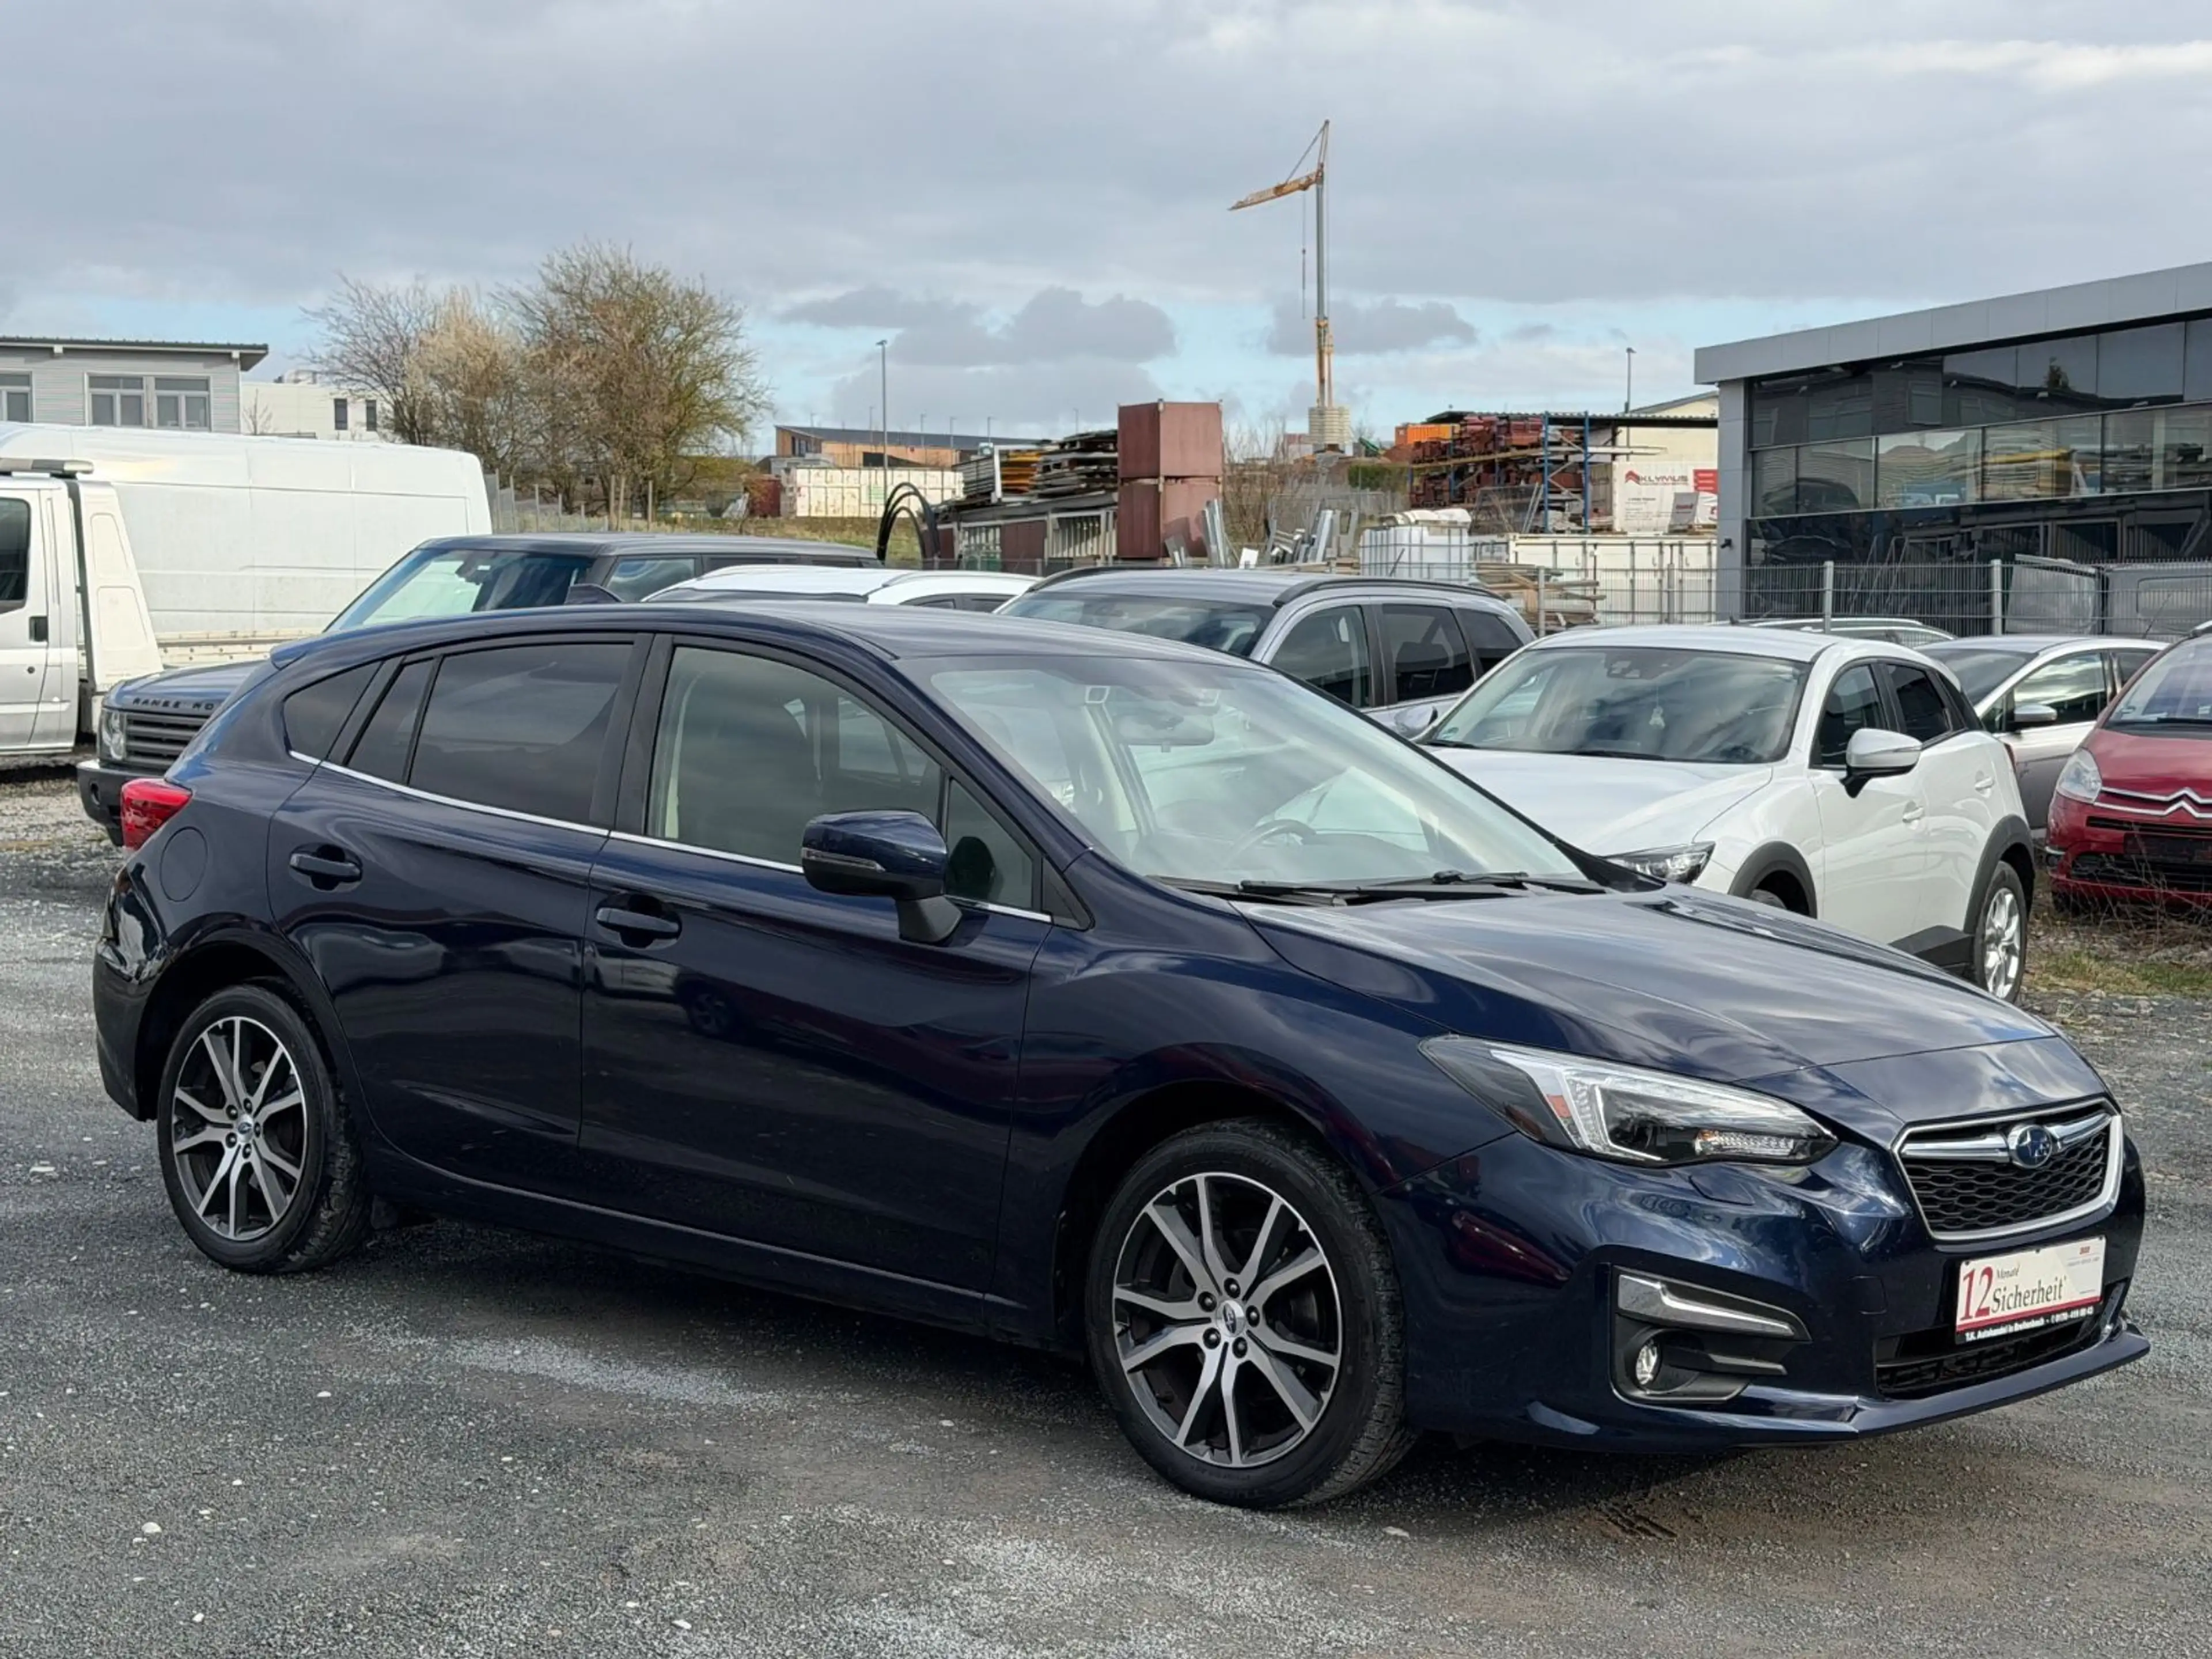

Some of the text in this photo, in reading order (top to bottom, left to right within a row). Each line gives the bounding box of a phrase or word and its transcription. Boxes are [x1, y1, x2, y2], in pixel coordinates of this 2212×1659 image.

[132, 696, 215, 711] RANGE RO
[1960, 1266, 1993, 1321] 12
